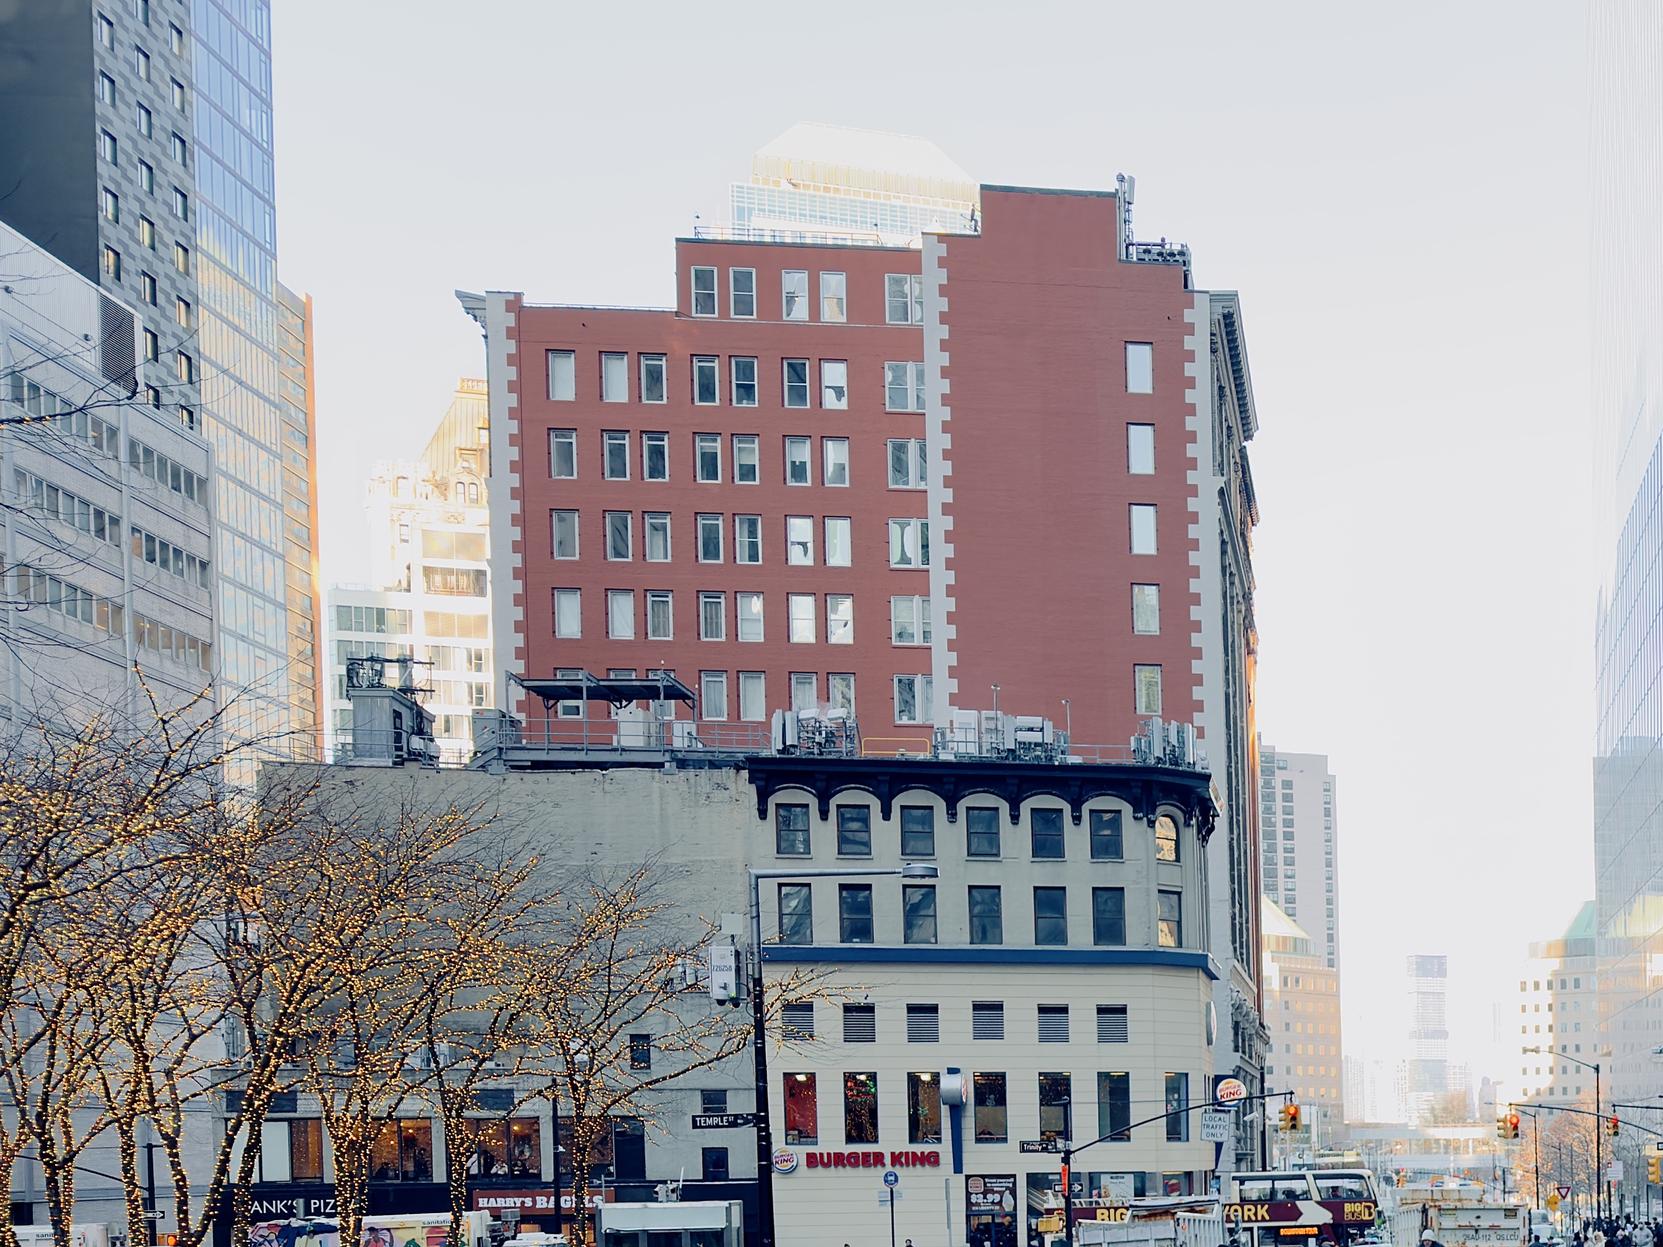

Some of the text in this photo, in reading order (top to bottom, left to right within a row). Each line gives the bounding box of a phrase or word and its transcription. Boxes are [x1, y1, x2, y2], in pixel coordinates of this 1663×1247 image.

[1218, 1084, 1241, 1093] BURGER
[1219, 1089, 1243, 1100] KING
[695, 1116, 729, 1127] TEMPLE
[774, 1157, 795, 1166] KING
[805, 1151, 941, 1169] BURGER KING
[478, 1195, 604, 1209] HARRY'S BAGLS
[1344, 1202, 1361, 1212] BIG
[1096, 1208, 1129, 1222] BIG
[1344, 1211, 1361, 1221] BUS
